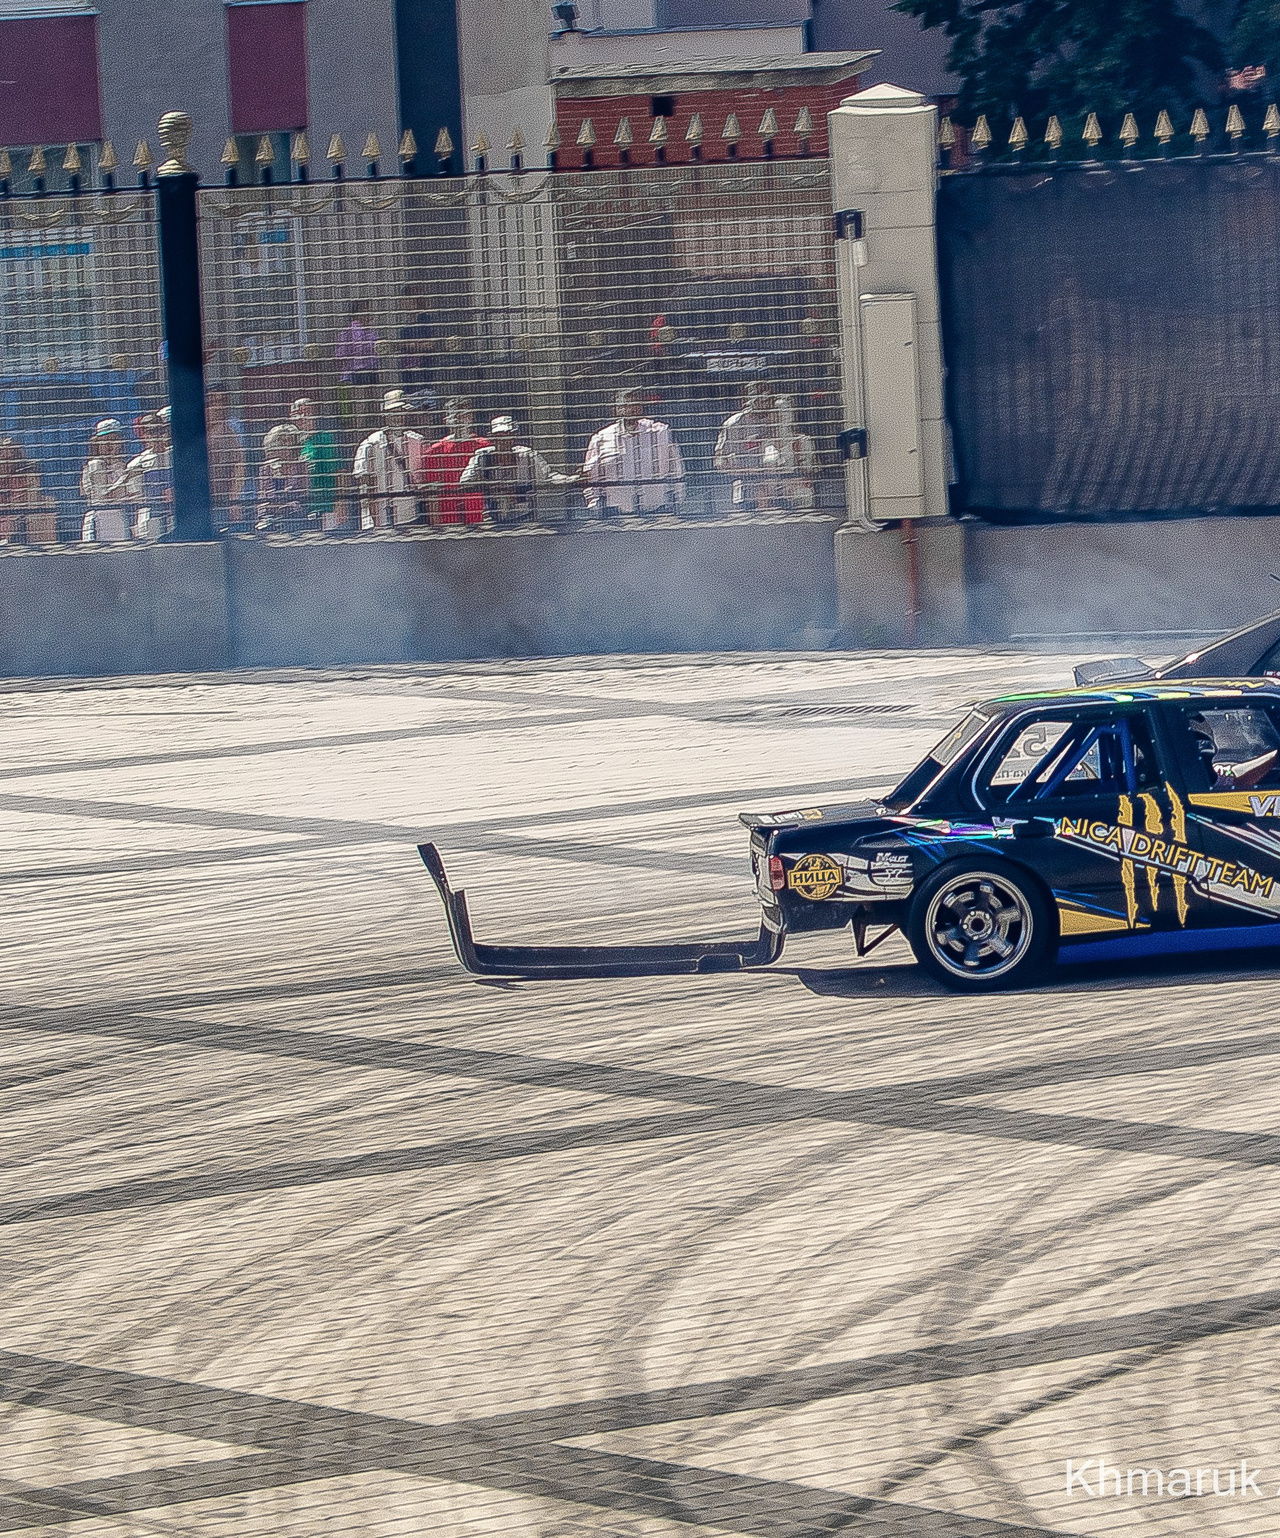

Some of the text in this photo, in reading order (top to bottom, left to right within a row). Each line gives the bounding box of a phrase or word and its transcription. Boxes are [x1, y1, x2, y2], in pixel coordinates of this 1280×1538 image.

[792, 871, 837, 884] НИЦА
[1060, 816, 1273, 897] NICA DRIFT TEAM
